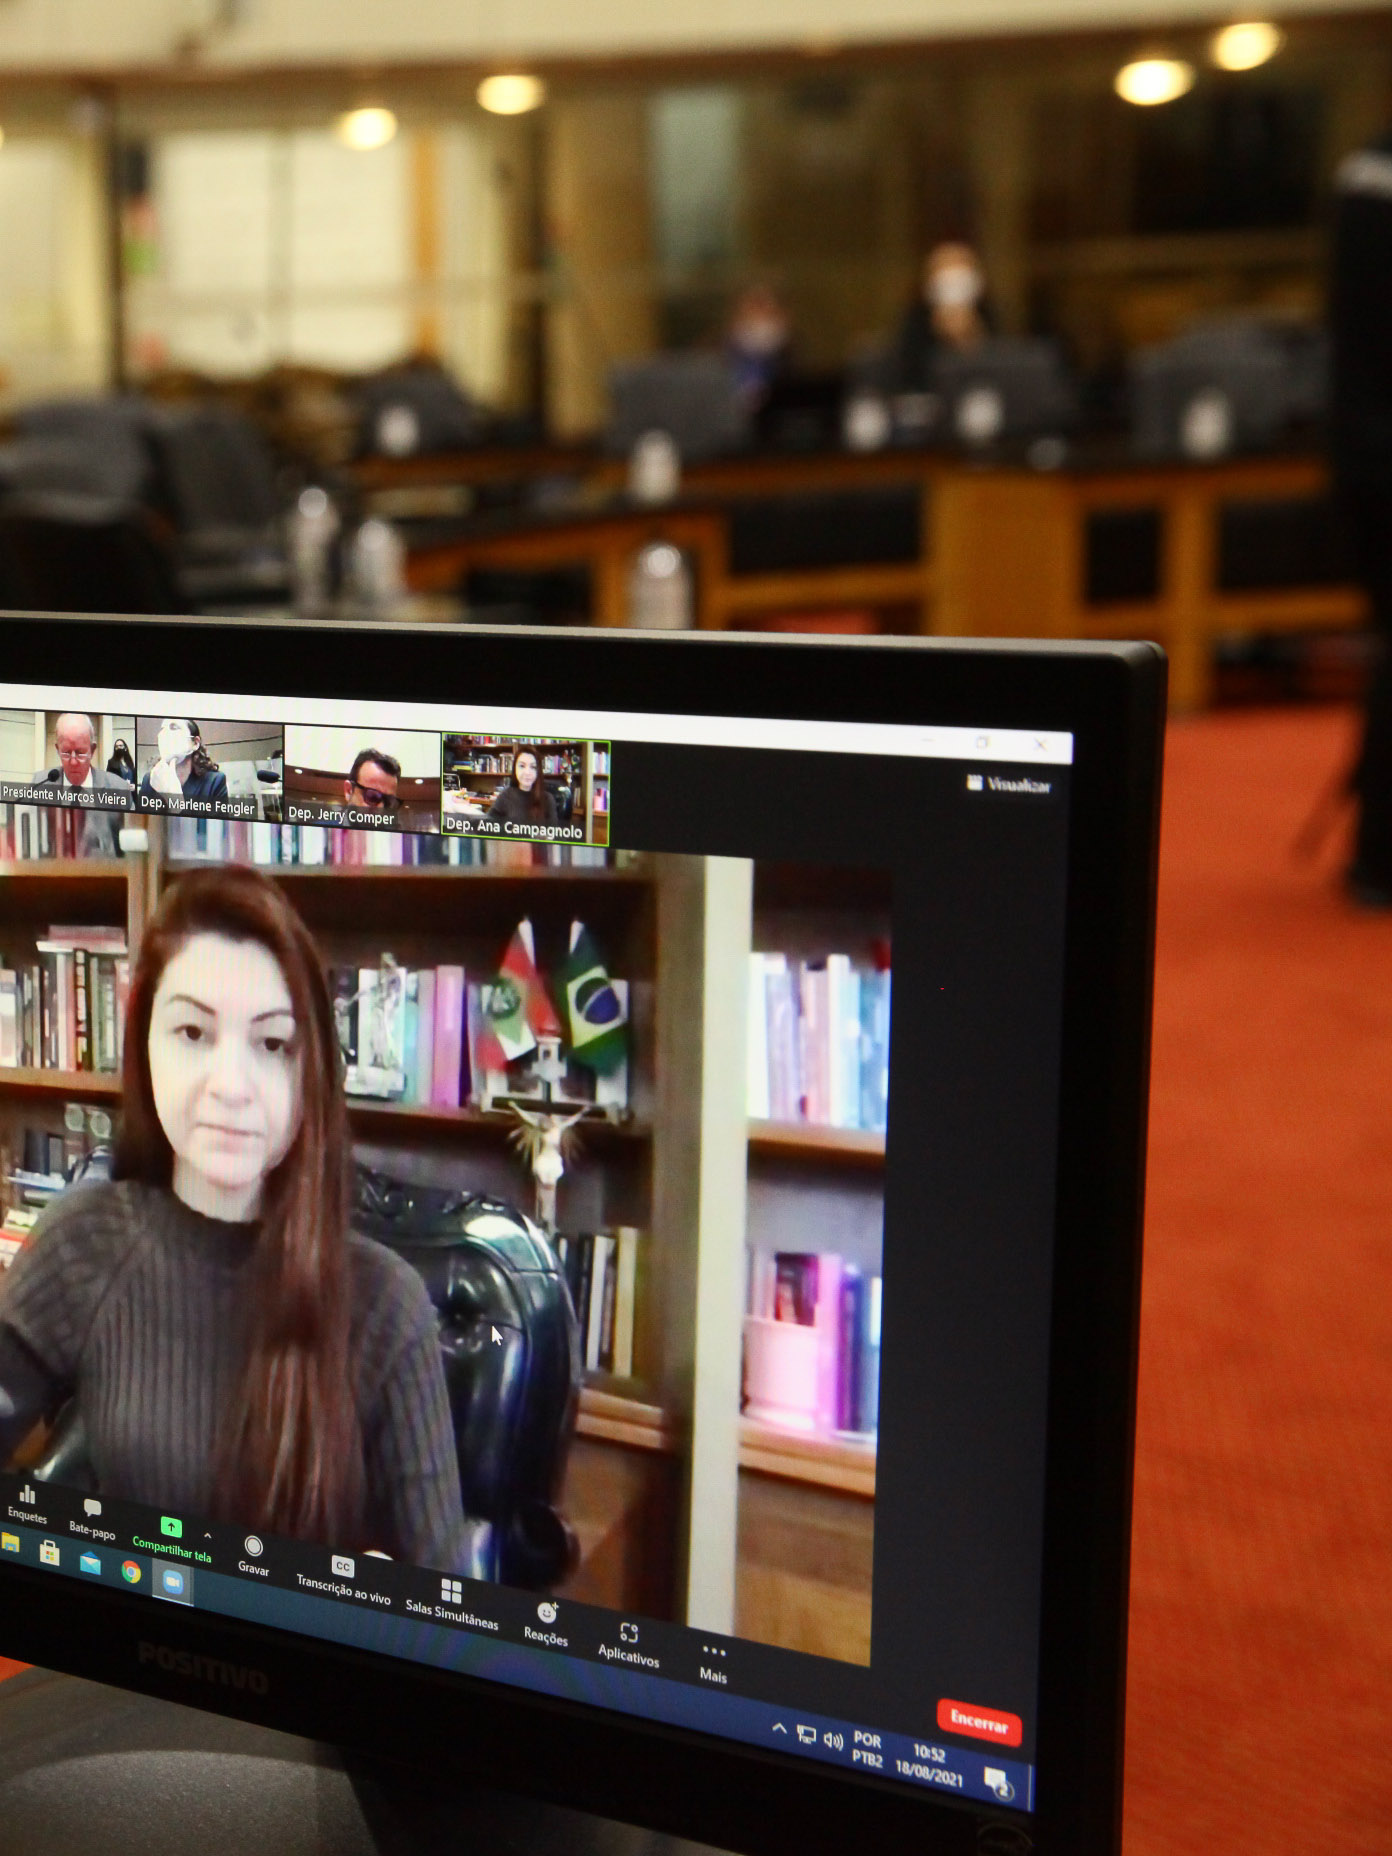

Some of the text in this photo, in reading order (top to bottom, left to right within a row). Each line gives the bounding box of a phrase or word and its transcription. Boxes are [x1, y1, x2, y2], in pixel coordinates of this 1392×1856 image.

[3, 786, 127, 805] Presidente Marcos Vieira
[141, 796, 255, 816] Dep. Marlene Fengler
[289, 806, 395, 827] Dep. Jerry Comper
[446, 817, 583, 840] Dep. Ana Campagnolo
[8, 1506, 47, 1525] Enquetes
[69, 1520, 116, 1541] Bate-papo
[132, 1536, 212, 1563] Compartilhar tela
[238, 1560, 269, 1577] Gravar
[336, 1561, 350, 1572] CC
[297, 1573, 391, 1606] Transcrição ao vivo
[406, 1599, 499, 1631] Salas Simultâneas
[524, 1626, 569, 1647] Reações
[598, 1643, 660, 1669] Aplicativos
[138, 1640, 269, 1696] POSITIVO
[700, 1666, 728, 1684] Mais
[951, 1708, 1009, 1735] Encerrar
[854, 1730, 881, 1749] POR
[852, 1748, 884, 1769] PTB2
[914, 1743, 946, 1764] 10:52
[896, 1759, 963, 1788] 18/08/2021
